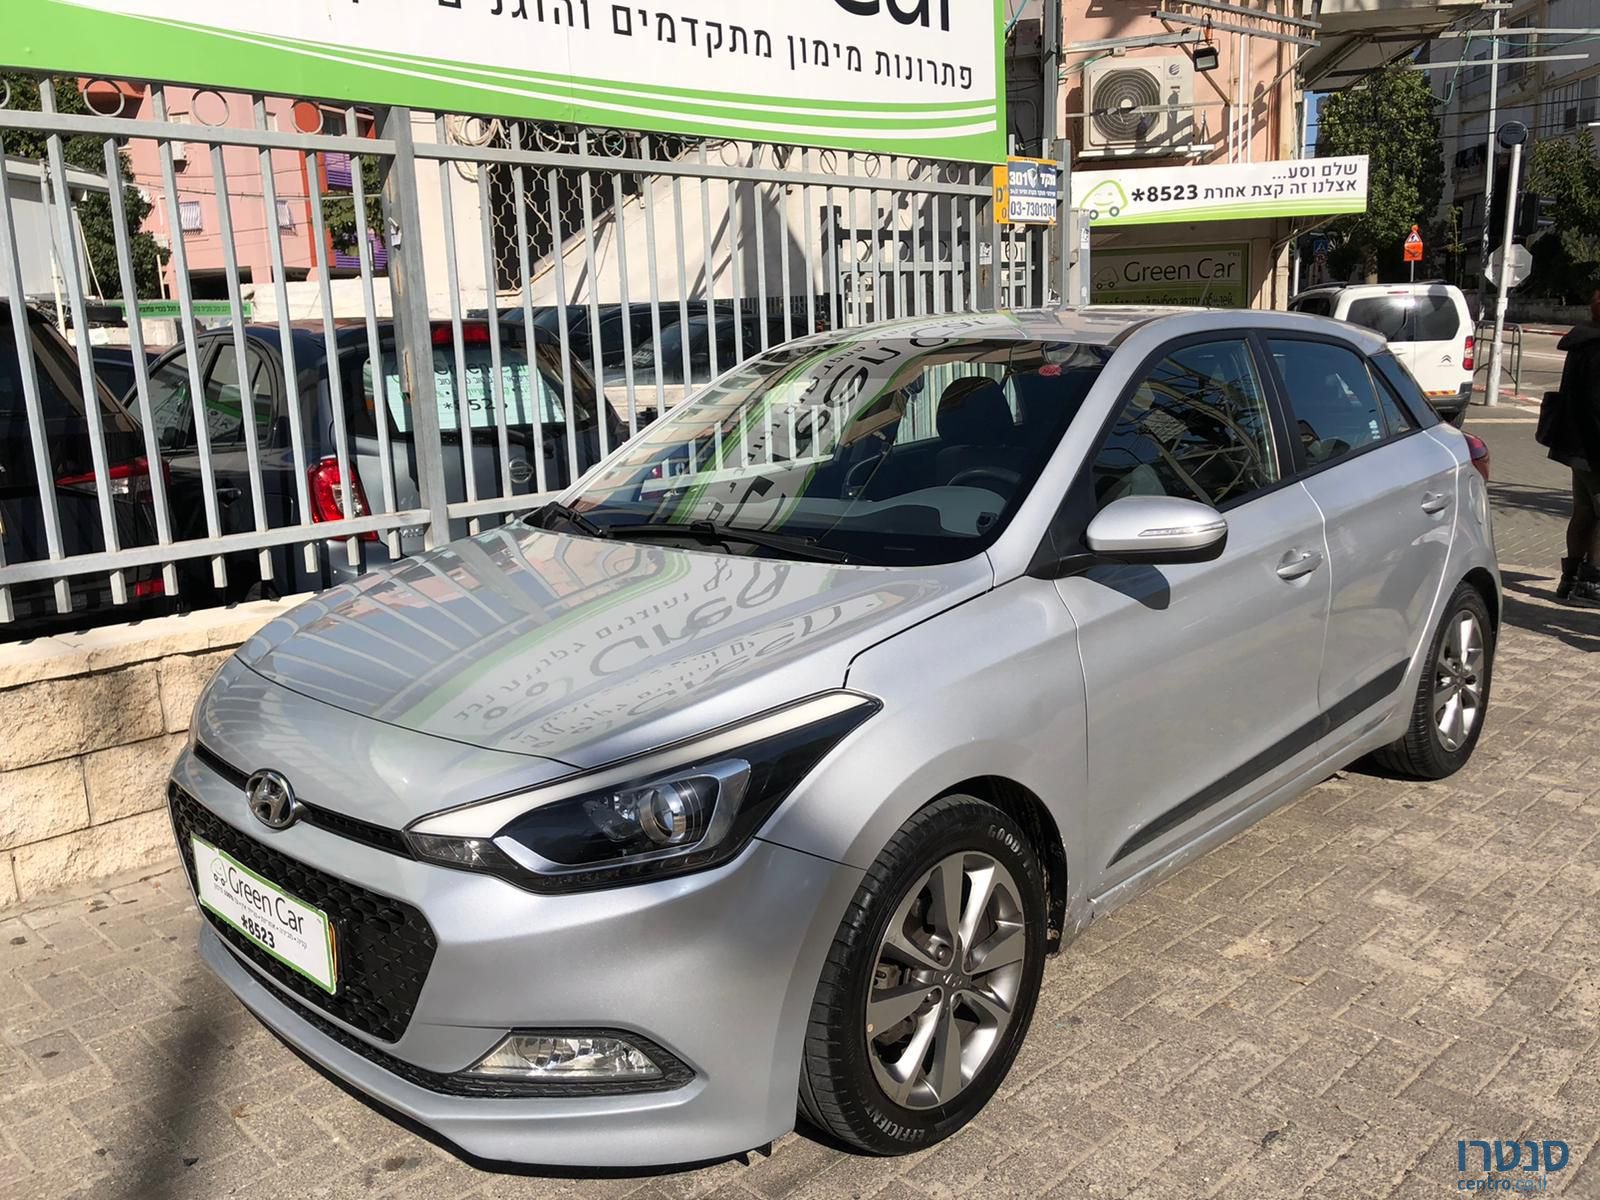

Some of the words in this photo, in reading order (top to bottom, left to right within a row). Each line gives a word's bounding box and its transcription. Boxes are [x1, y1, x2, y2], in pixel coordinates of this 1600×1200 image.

[612, 4, 773, 58] מתקדמים
[787, 35, 862, 72] מימון
[875, 50, 972, 90] פתרונות
[1272, 166, 1315, 180] וסע...
[1321, 162, 1358, 176] שלם
[1009, 171, 1028, 186] 301
[1313, 178, 1357, 192] אצלנו
[1203, 186, 1246, 199] אחרת
[1251, 184, 1284, 199] קצת
[1290, 182, 1307, 194] זה
[1010, 201, 1056, 217] 03-7301301
[1123, 261, 1190, 282] Green
[1197, 258, 1235, 279] Car
[228, 867, 272, 917] Green
[275, 897, 304, 935] Car
